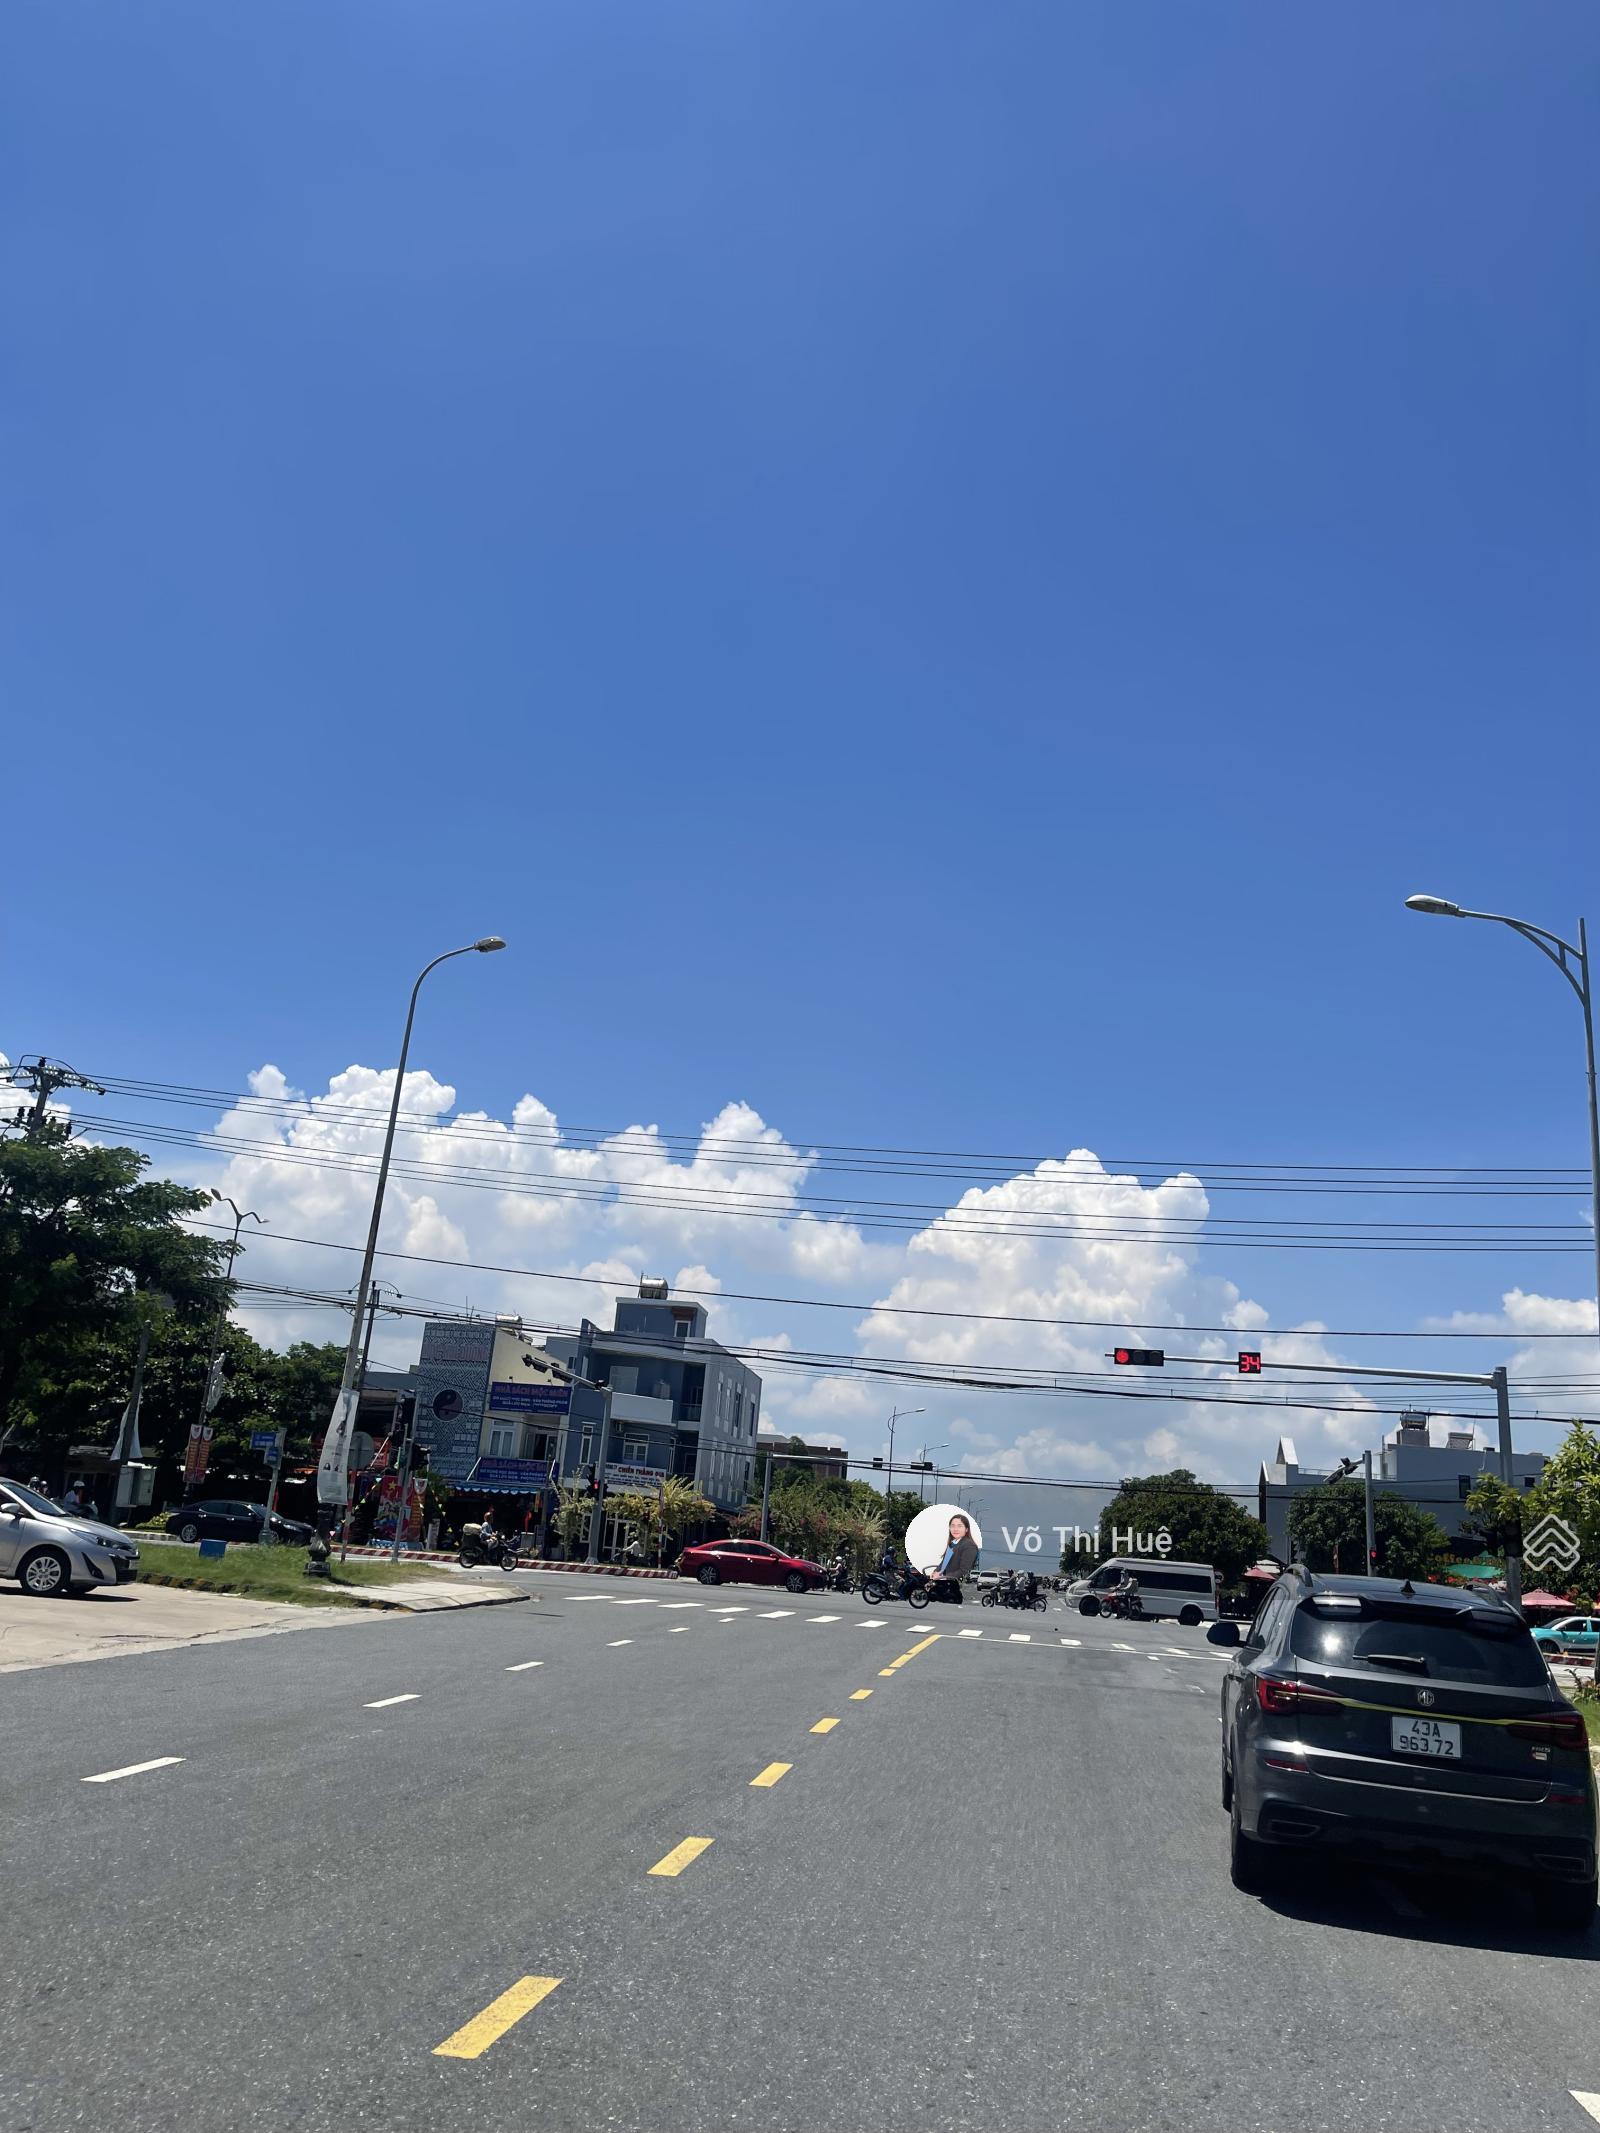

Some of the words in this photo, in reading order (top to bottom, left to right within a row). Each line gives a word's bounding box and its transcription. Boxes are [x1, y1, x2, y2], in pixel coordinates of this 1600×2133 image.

[1418, 1690, 1434, 1705] MG
[1411, 1718, 1441, 1738] 43A
[1399, 1735, 1454, 1756] 963.72
